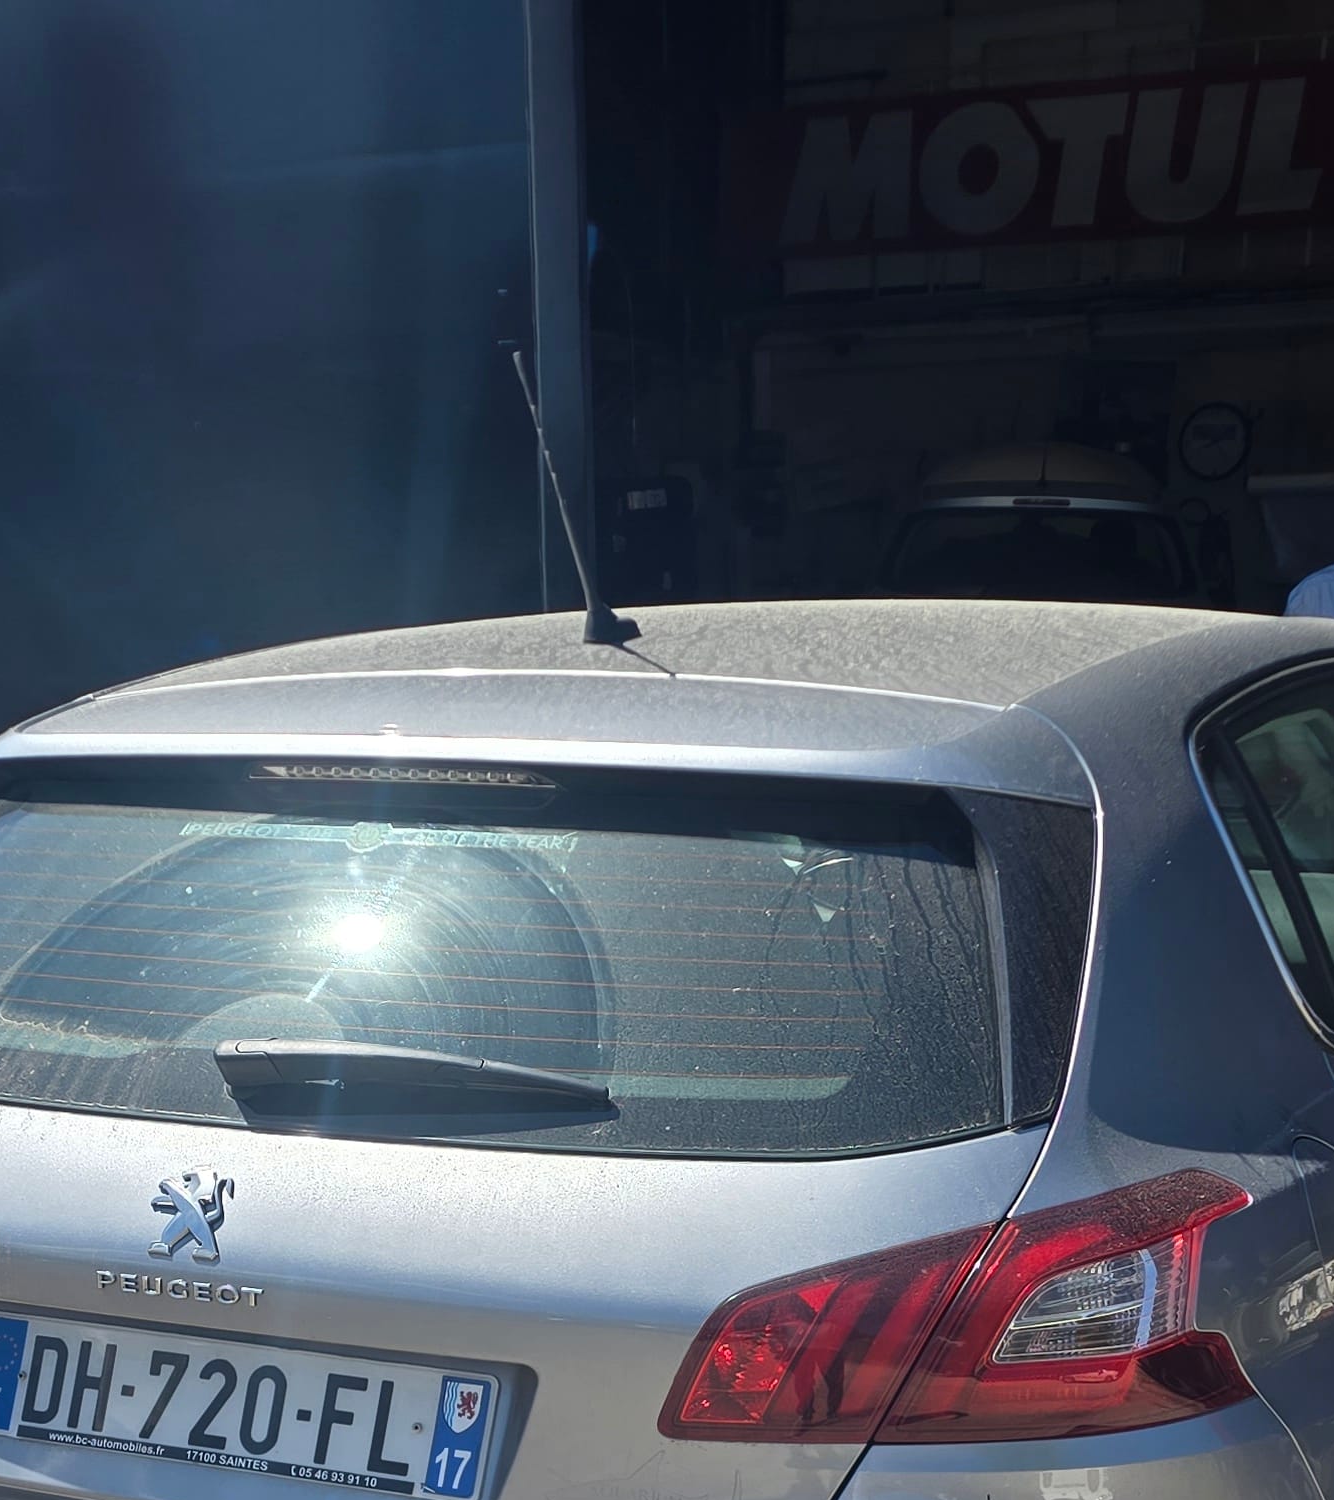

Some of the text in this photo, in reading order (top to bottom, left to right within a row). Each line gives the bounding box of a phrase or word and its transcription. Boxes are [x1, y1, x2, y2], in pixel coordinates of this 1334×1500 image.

[779, 77, 1323, 236] MOTUL
[189, 822, 281, 837] PEUGEOT
[516, 834, 564, 850] YEAR
[96, 1270, 265, 1308] PEUGEOT
[21, 1335, 410, 1477] DH-720-FL
[48, 1432, 165, 1456] www.bc-automobiles.fr
[186, 1449, 269, 1471] 17100 SAINTES
[298, 1467, 378, 1488] 05 46 93 91 10
[434, 1447, 472, 1490] 17
